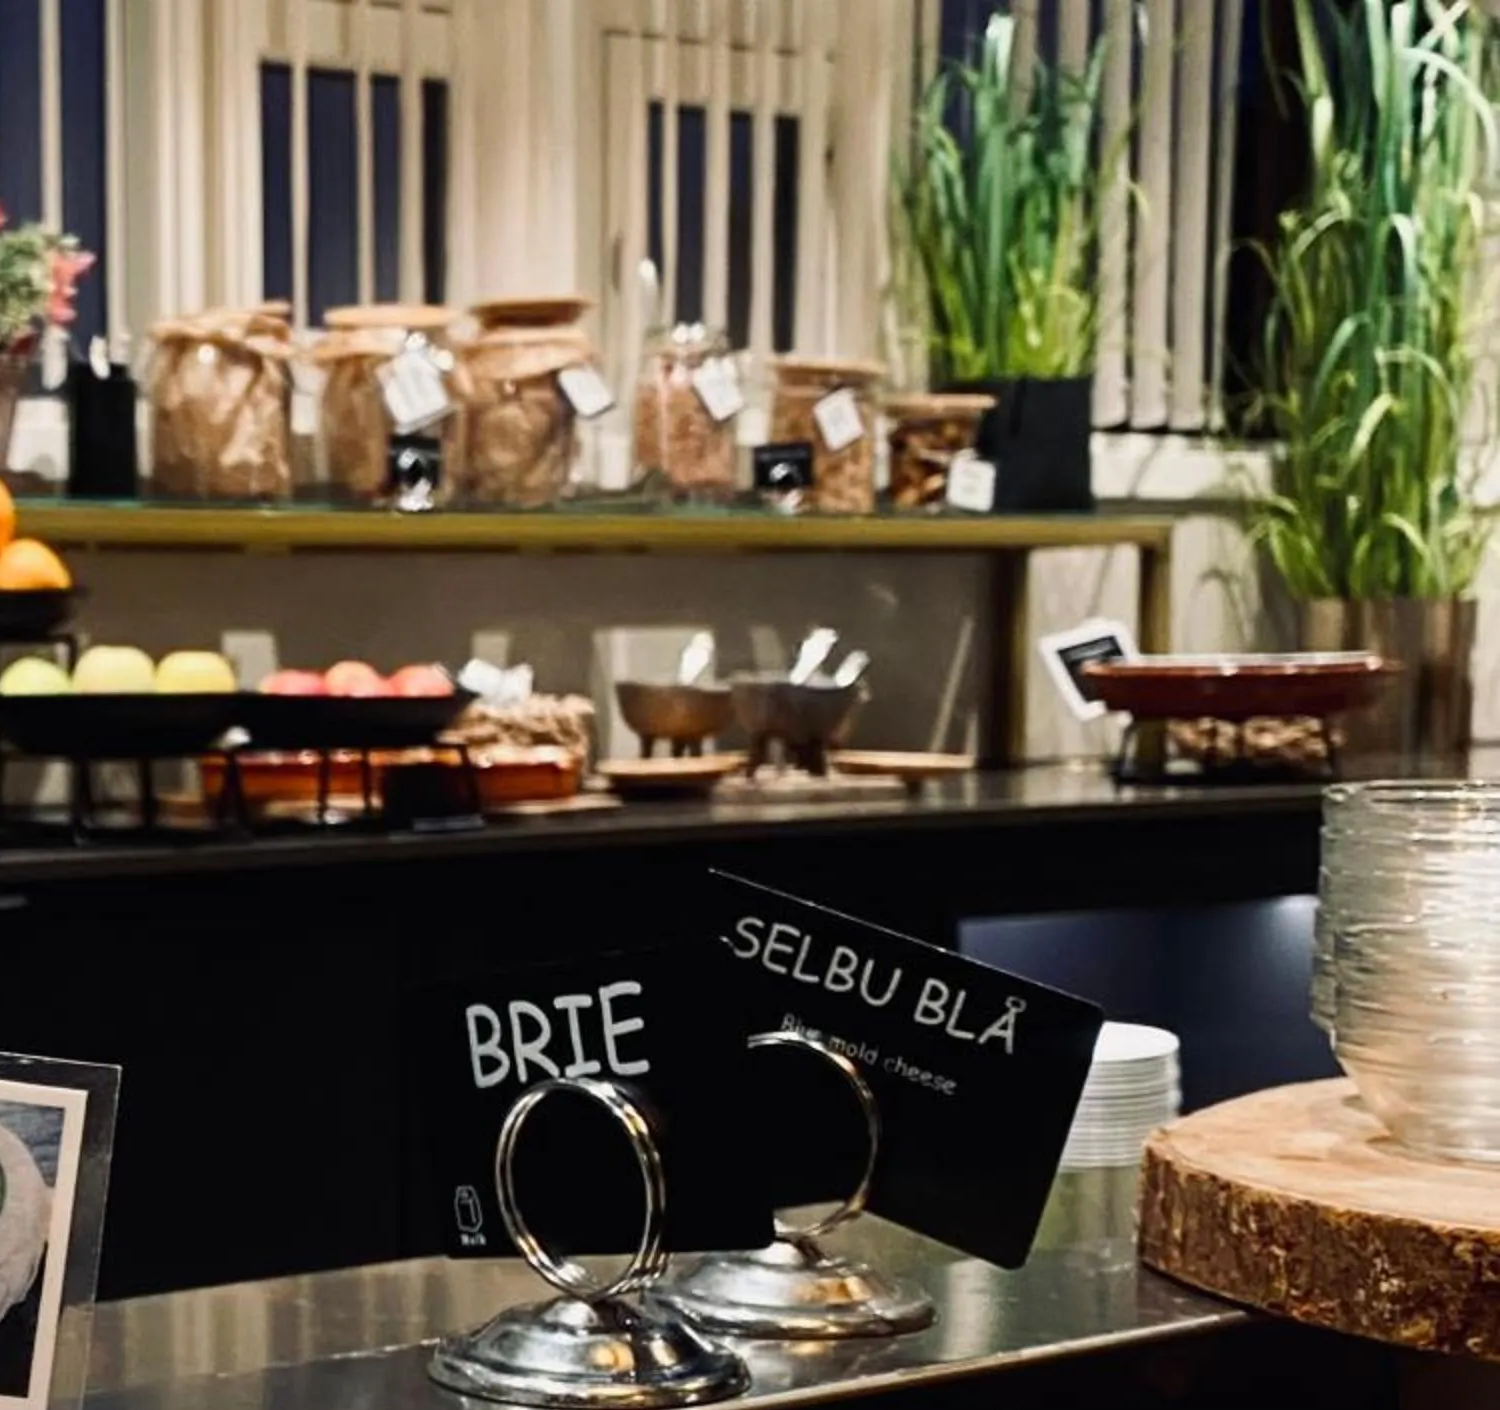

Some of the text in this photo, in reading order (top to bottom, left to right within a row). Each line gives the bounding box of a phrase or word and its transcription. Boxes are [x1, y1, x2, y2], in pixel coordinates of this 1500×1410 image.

[466, 981, 651, 1089] BRIE
[719, 916, 1027, 1055] SELBU BLÅ
[828, 1033, 880, 1065] mold
[883, 1056, 958, 1096] cheese
